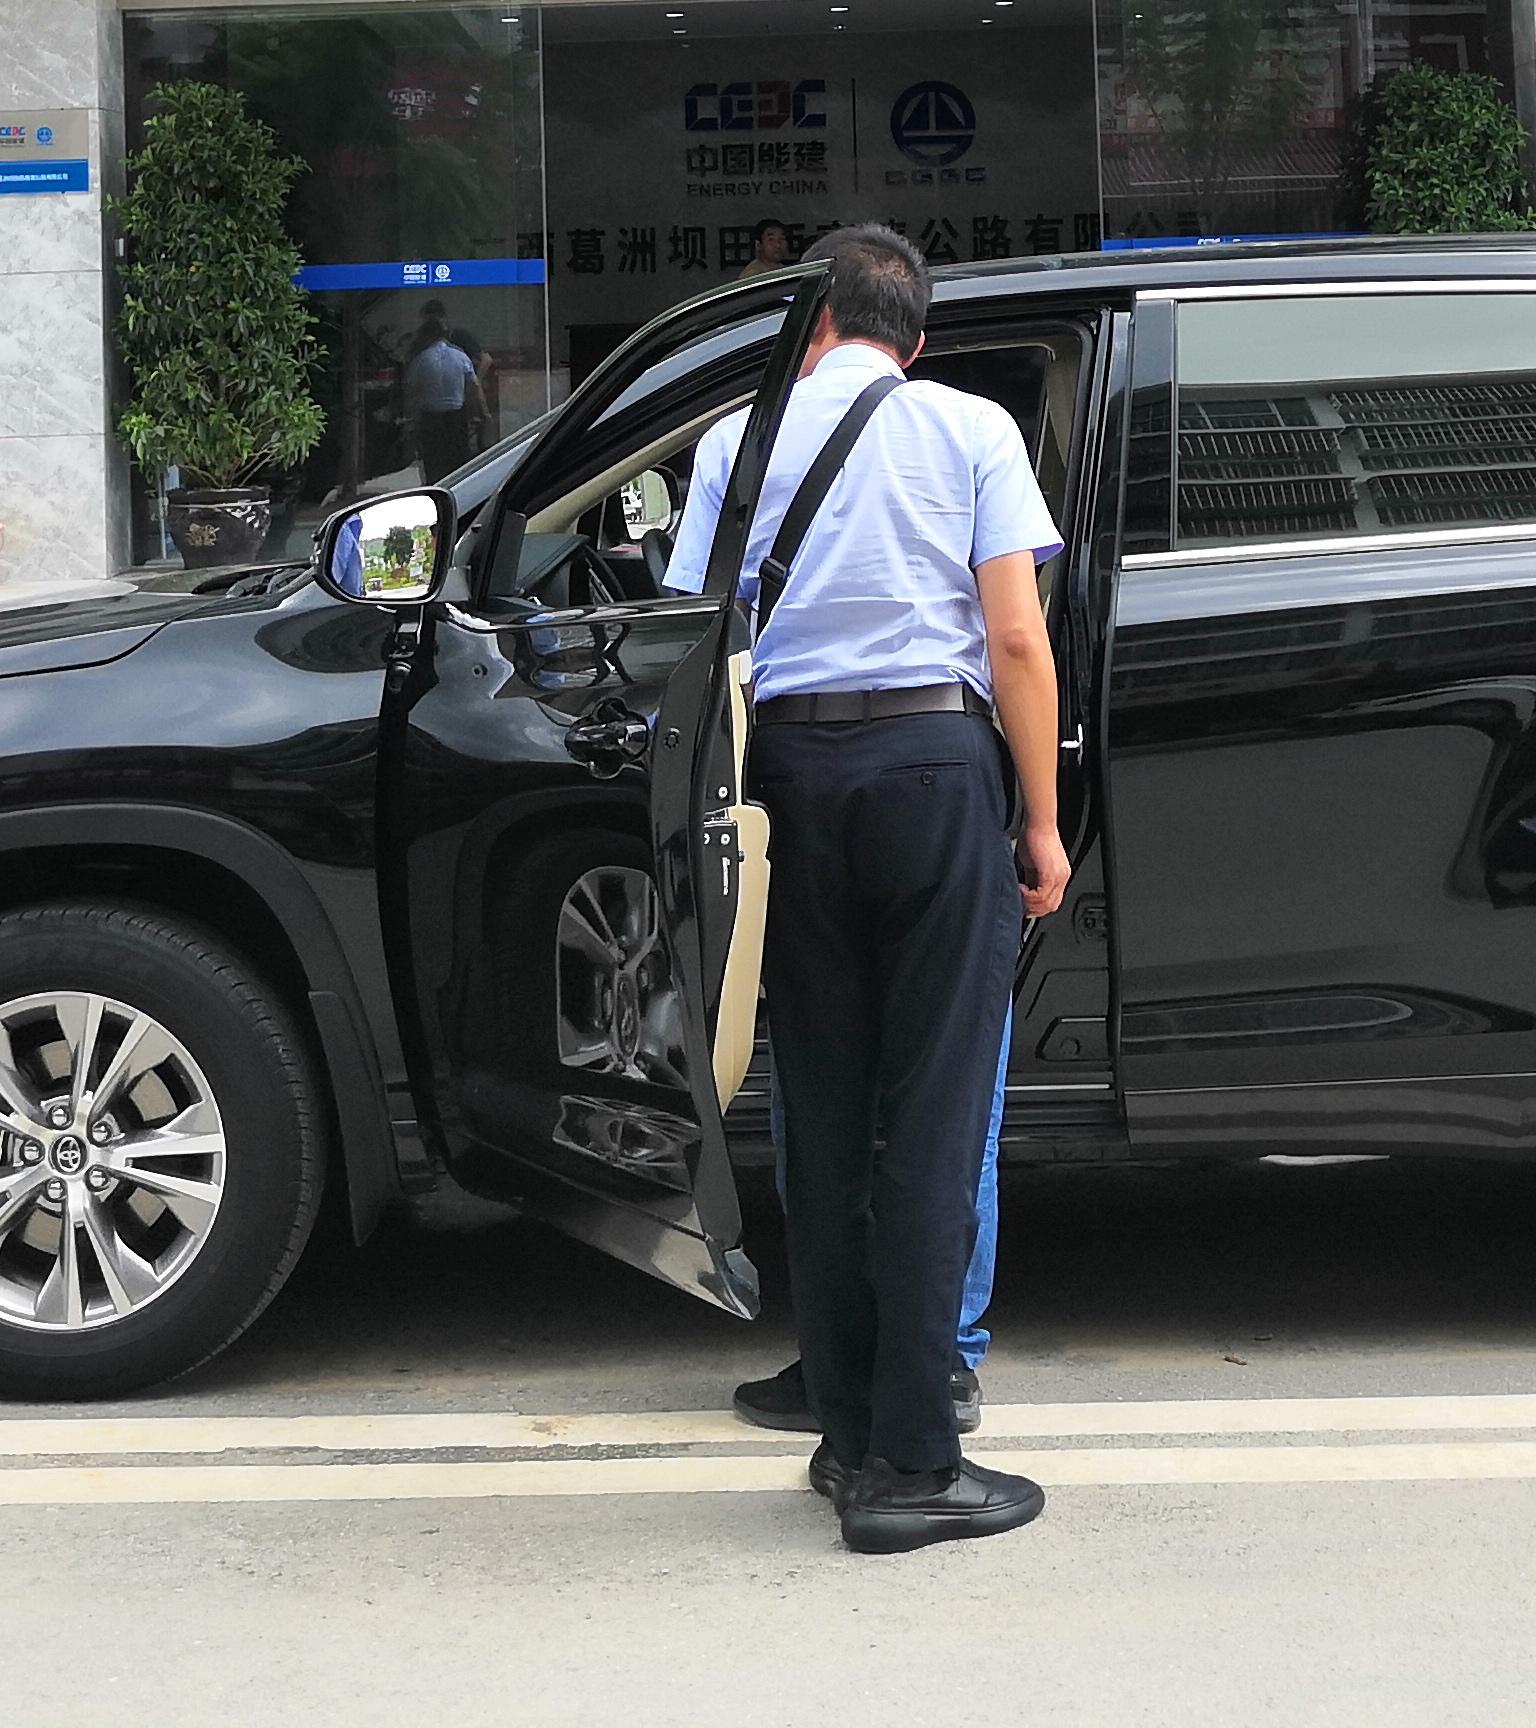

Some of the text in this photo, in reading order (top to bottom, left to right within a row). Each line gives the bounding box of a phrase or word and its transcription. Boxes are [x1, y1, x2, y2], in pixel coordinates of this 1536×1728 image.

[685, 140, 828, 176] 中国能建
[686, 178, 828, 198] ENERGY CHINA
